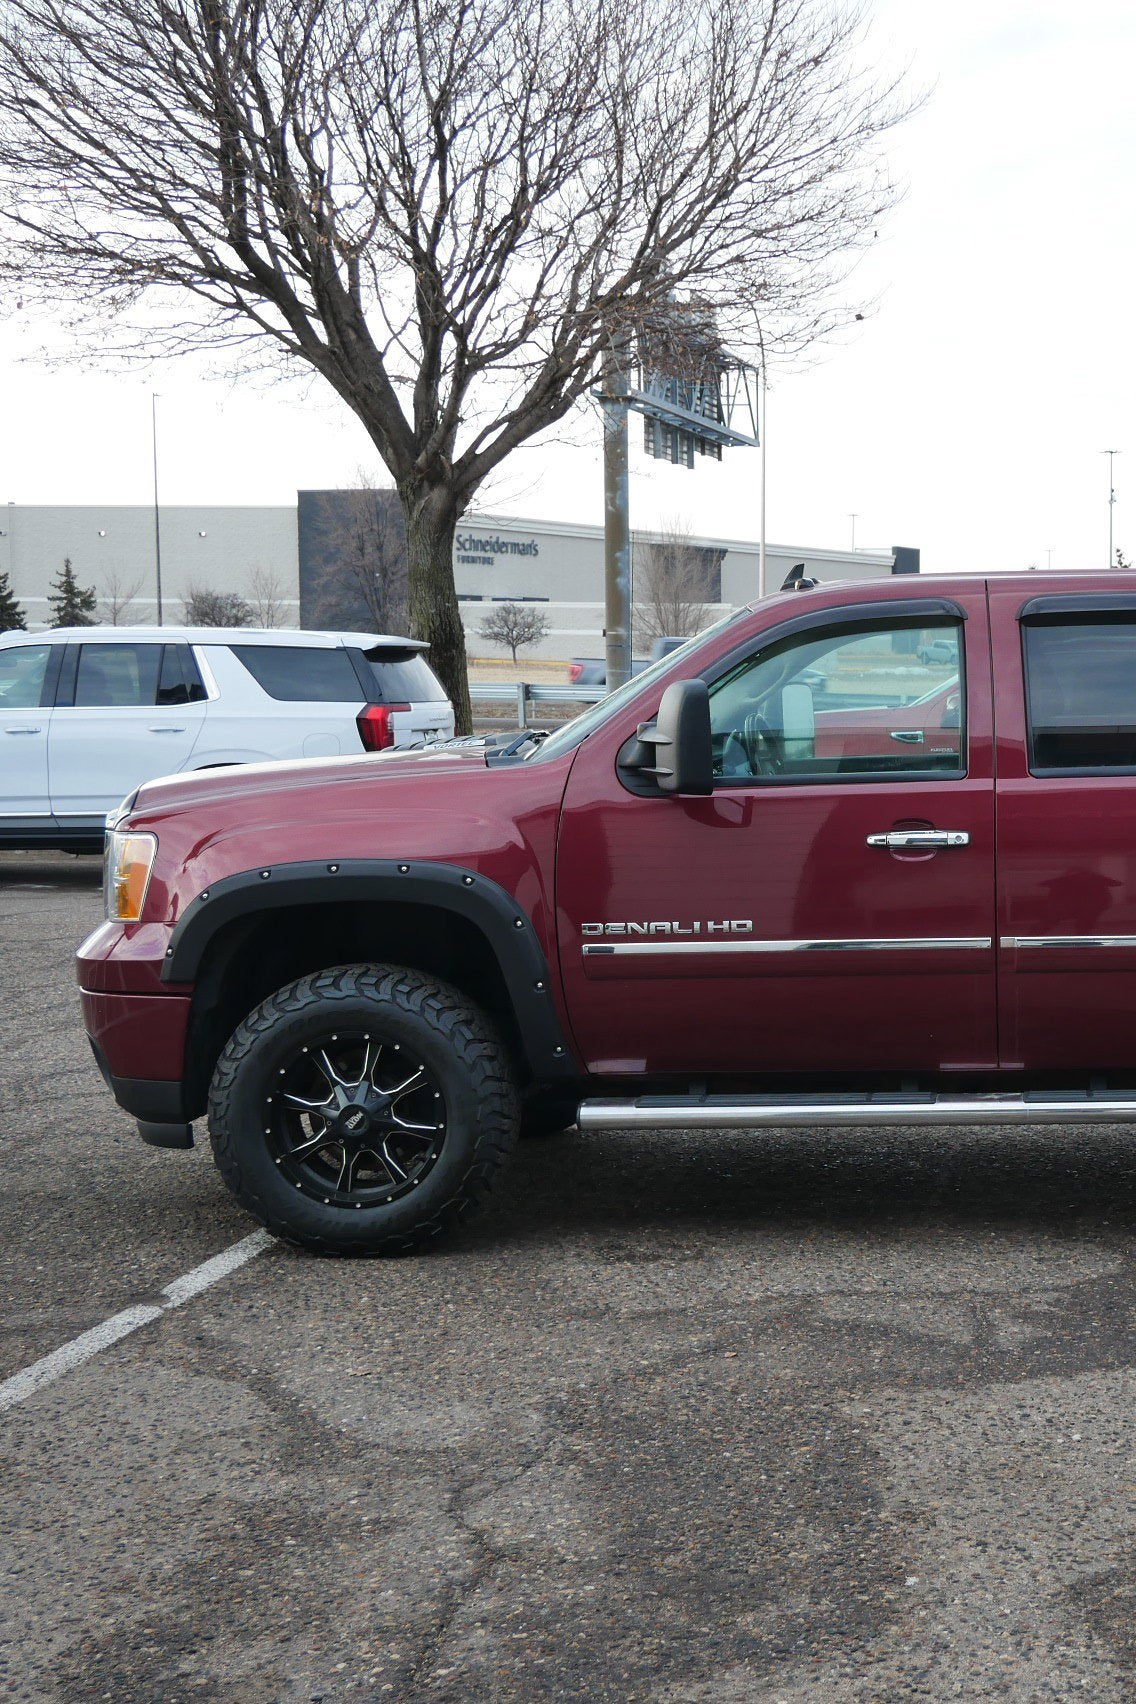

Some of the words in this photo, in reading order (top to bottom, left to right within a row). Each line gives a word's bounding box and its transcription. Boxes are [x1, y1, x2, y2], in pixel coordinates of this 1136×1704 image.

[456, 533, 539, 557] Schneiderman's
[456, 554, 495, 566] FURNITURE
[581, 921, 701, 936] DENALI
[707, 919, 753, 933] HD
